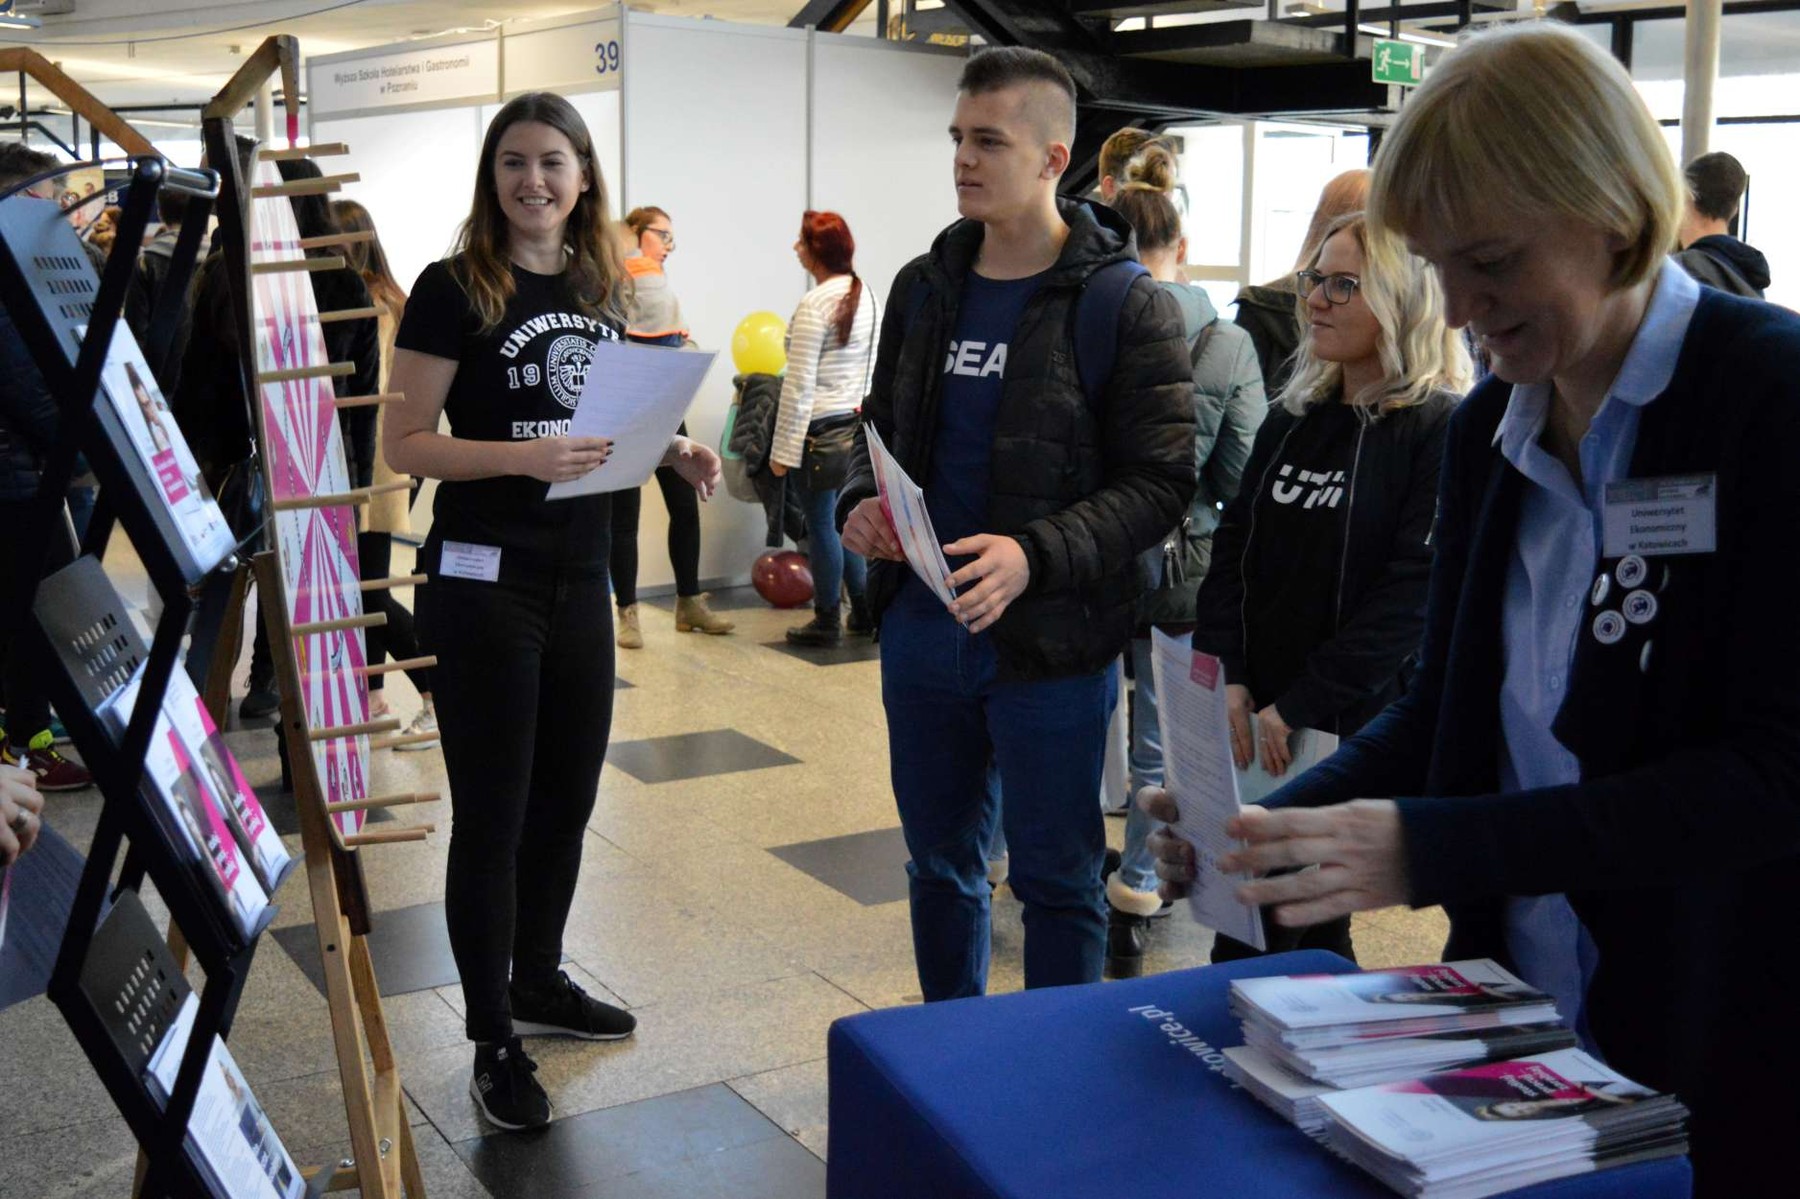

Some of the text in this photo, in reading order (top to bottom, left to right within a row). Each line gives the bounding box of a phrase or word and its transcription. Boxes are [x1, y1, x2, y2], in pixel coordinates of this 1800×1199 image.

[594, 41, 620, 74] 39
[381, 63, 420, 78] Hotelarstwa
[426, 56, 470, 72] Gastronomii
[386, 79, 418, 93] Poznaniu
[507, 363, 540, 389] 19
[511, 419, 571, 438] EKONO
[1630, 507, 1686, 518] Uniwersytet
[1629, 524, 1688, 535] Ekonomiczny
[1638, 539, 1690, 549] Katowicach
